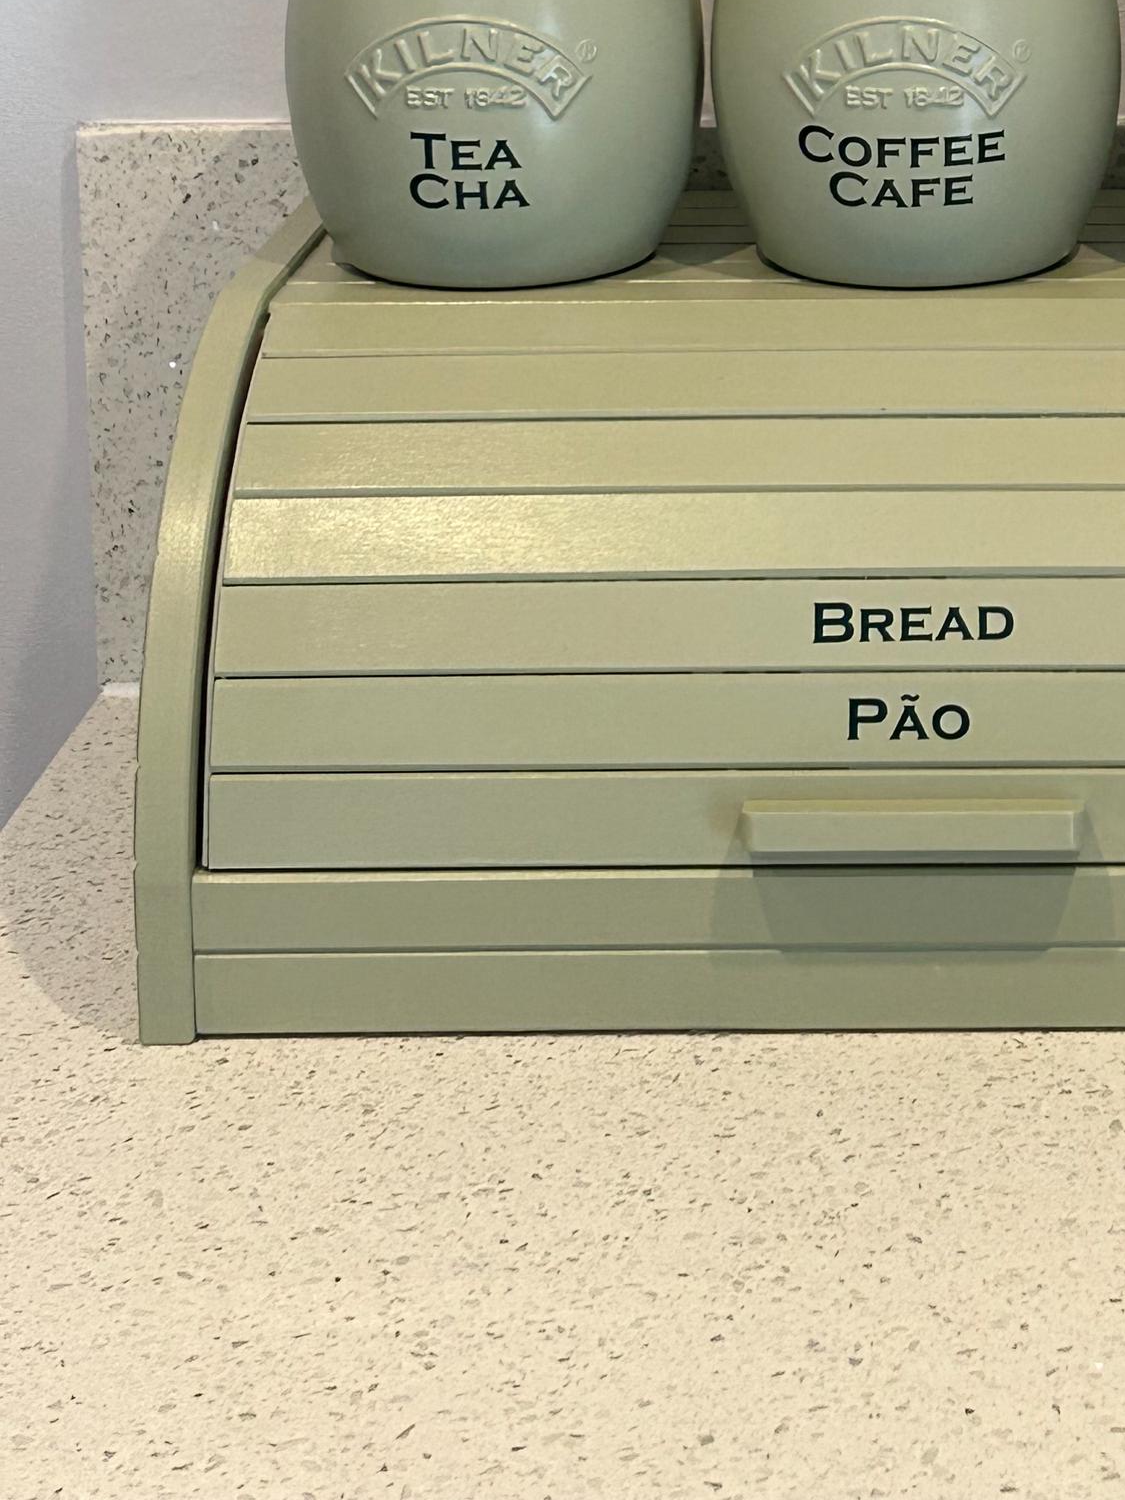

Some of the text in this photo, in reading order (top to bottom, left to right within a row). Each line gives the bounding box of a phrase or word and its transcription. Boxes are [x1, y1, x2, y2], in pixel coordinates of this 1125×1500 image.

[356, 26, 577, 101] KILNER
[800, 25, 1016, 100] KILNER
[405, 85, 454, 110] EST
[845, 85, 893, 110] EST
[409, 131, 522, 171] TEA
[798, 124, 1006, 169] COFFEE
[408, 173, 531, 210] CHA
[829, 171, 974, 208] CAFE
[812, 602, 1015, 644] BREAD
[847, 694, 971, 741] PÃO
